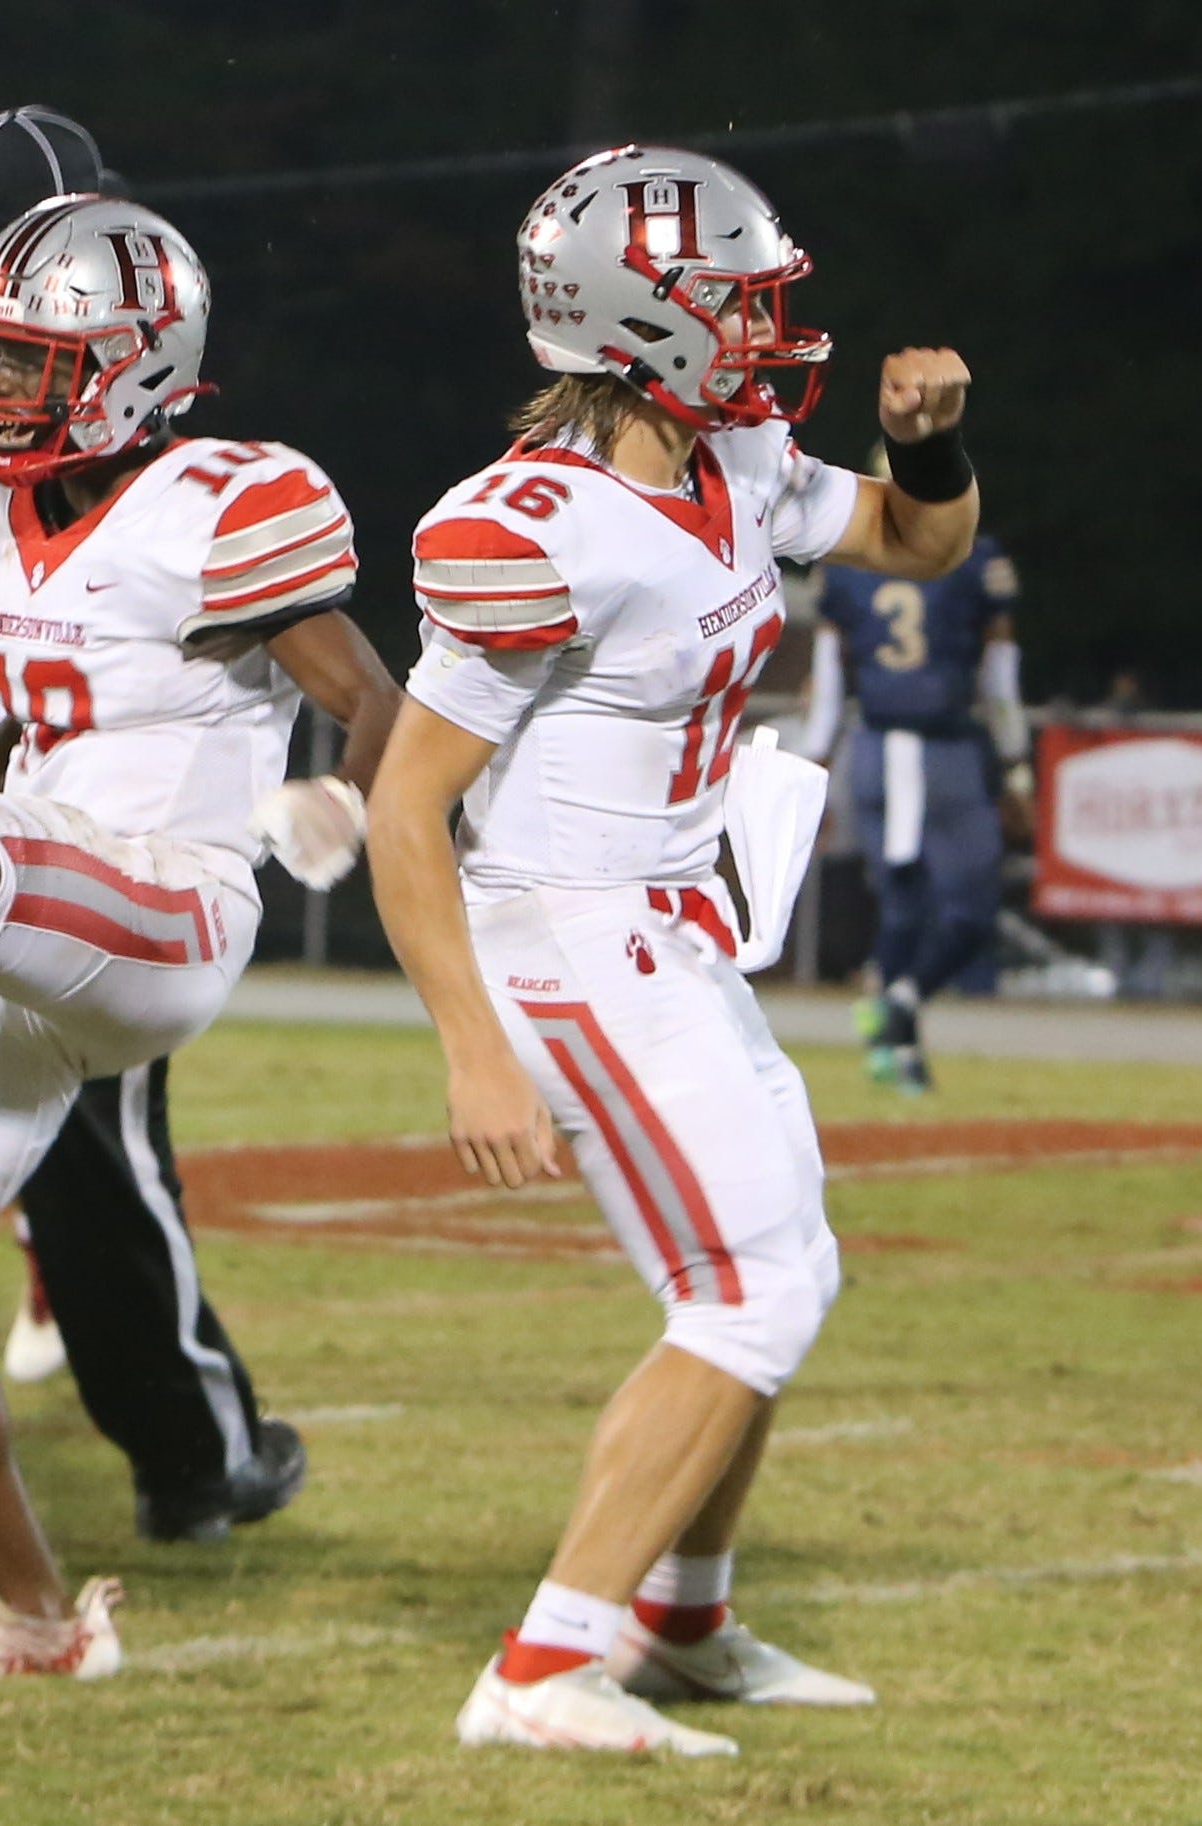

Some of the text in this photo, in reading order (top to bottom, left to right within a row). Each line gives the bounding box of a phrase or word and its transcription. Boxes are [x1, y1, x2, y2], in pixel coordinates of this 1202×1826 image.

[614, 177, 715, 263] H
[97, 231, 178, 313] H
[460, 472, 572, 521] 16
[872, 581, 929, 671] 3
